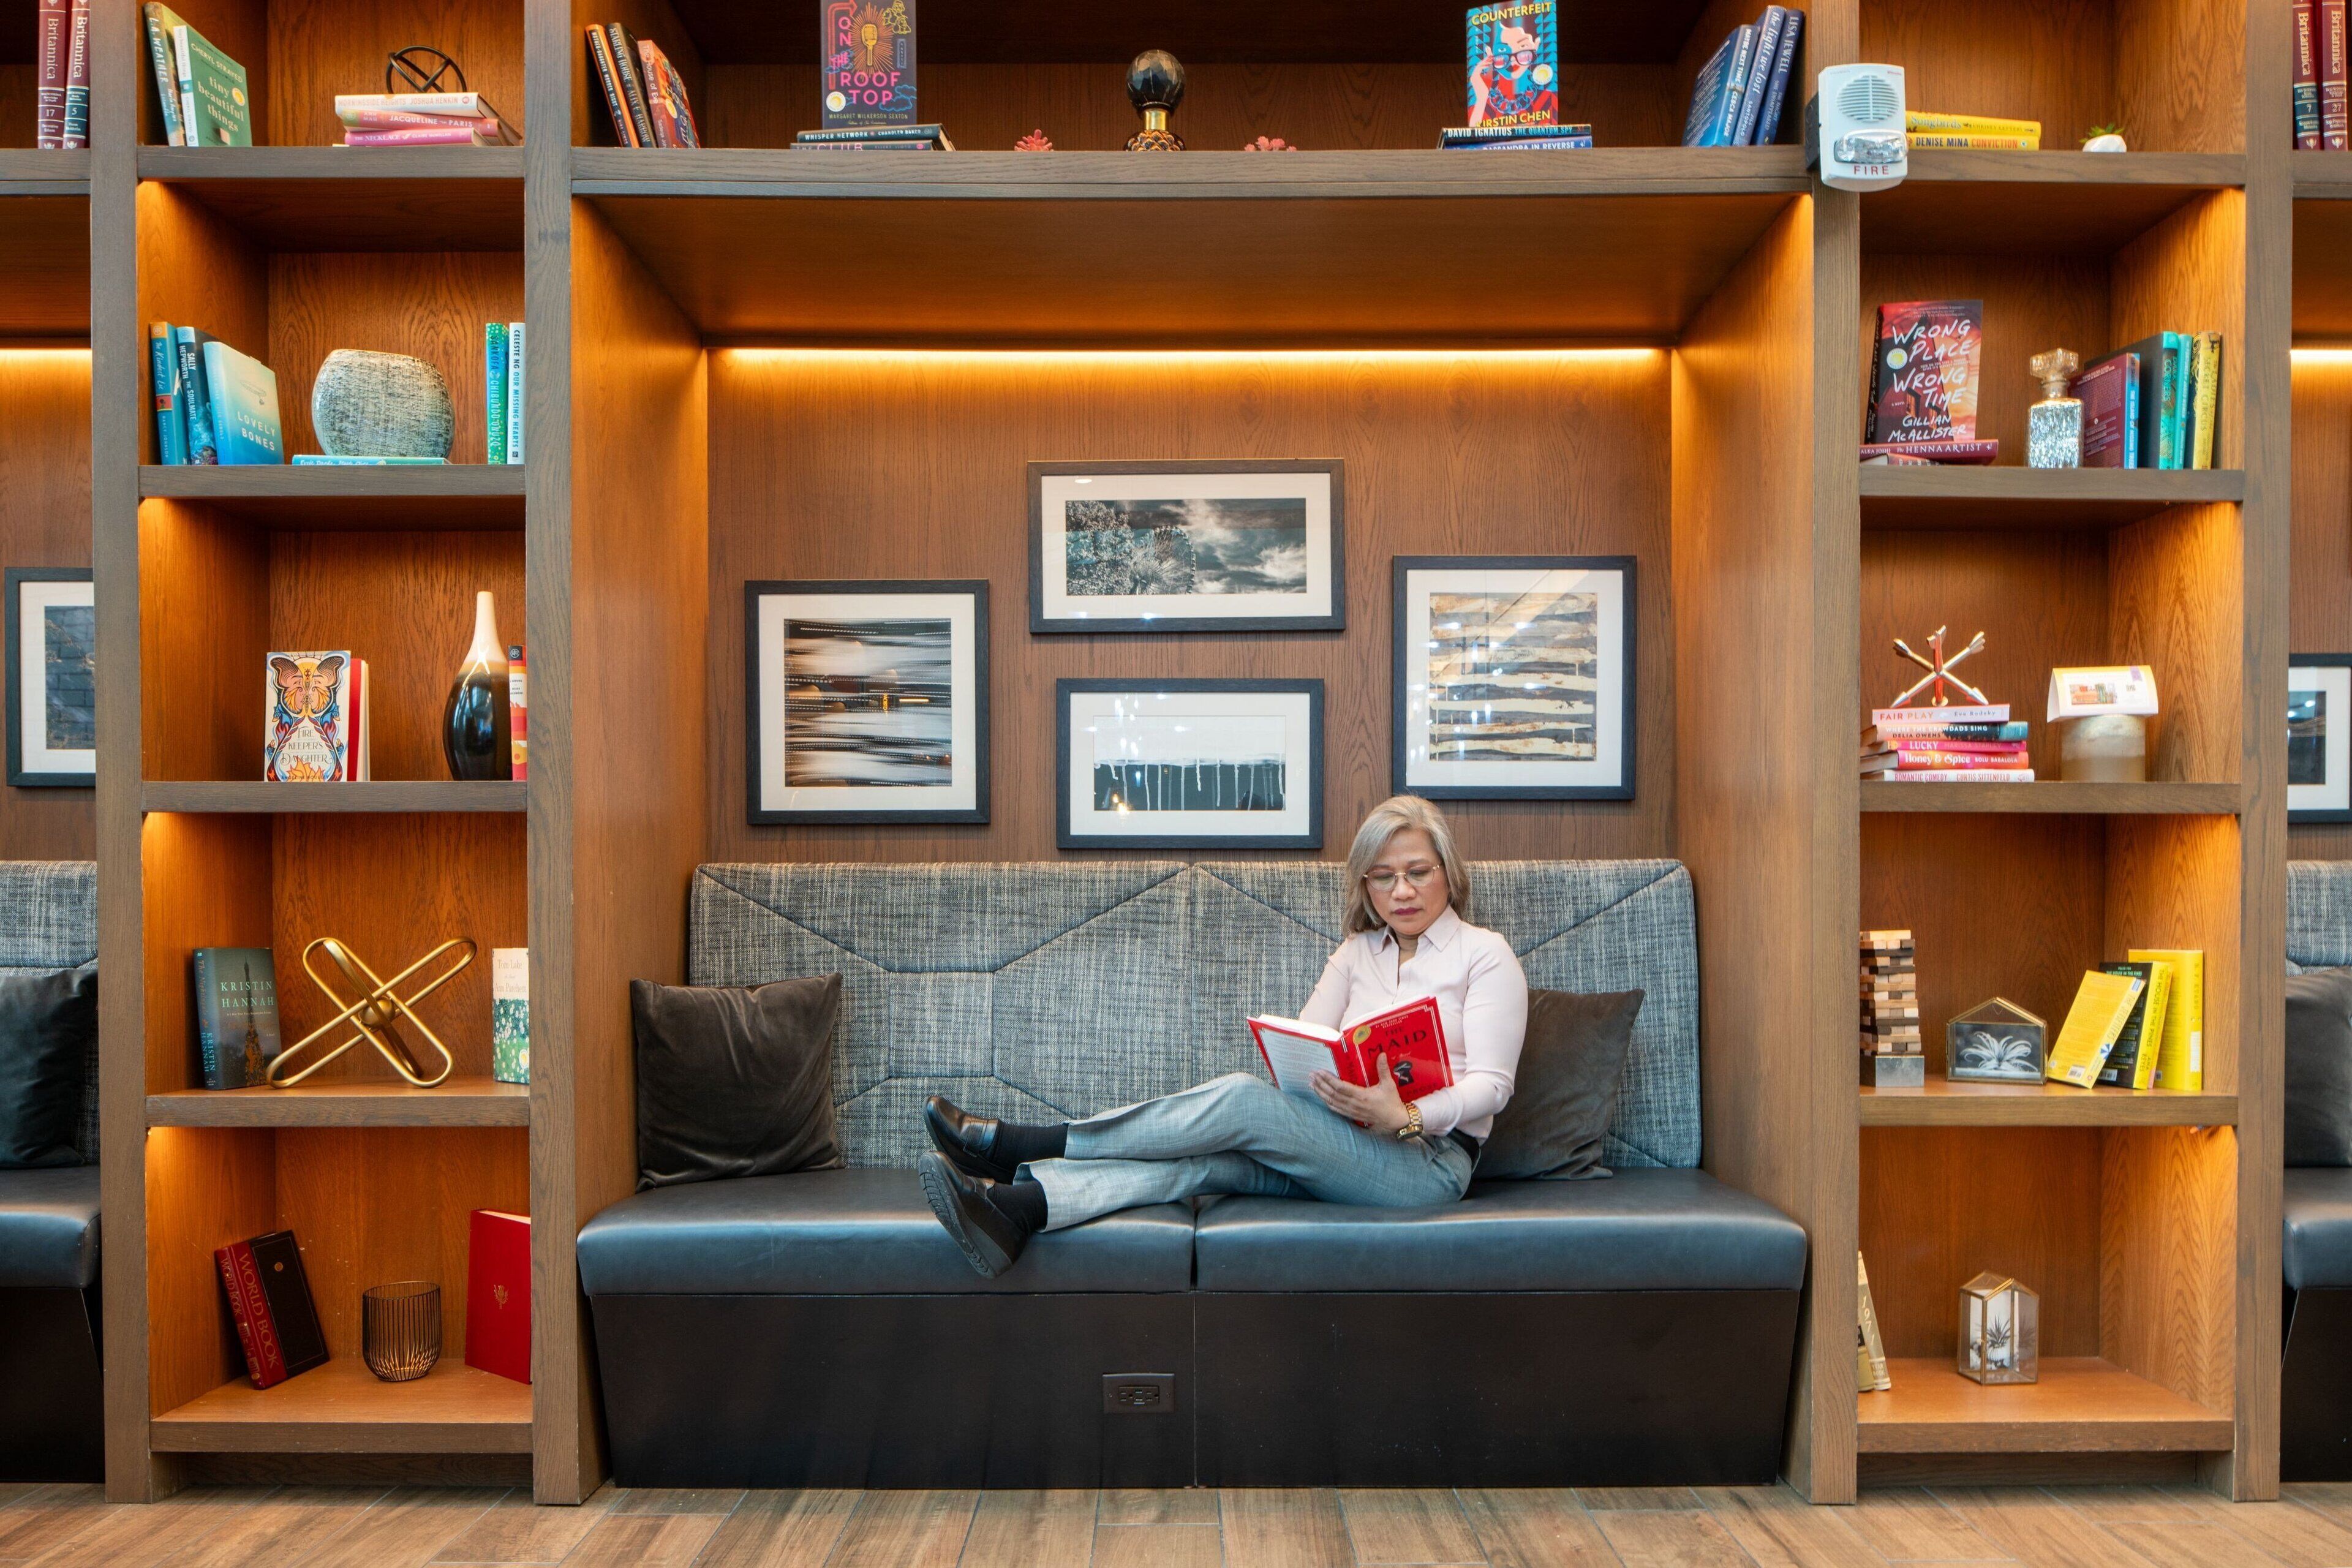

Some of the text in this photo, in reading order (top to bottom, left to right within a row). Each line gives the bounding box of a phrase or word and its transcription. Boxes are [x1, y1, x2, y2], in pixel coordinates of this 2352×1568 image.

[1471, 2, 1553, 26] COUNTERFEIT
[47, 18, 59, 80] Britannica
[73, 17, 88, 78] Britannica
[1752, 12, 1781, 94] the light we lost
[1778, 16, 1799, 74] LISA JEWELL
[2298, 12, 2311, 76] Britannica
[2331, 10, 2342, 75] Britannica
[153, 37, 169, 83] WEATHER
[191, 43, 243, 83] CHERYL STRAYED
[829, 51, 849, 70] THE
[646, 62, 655, 84] House
[840, 71, 901, 88] ROOF
[1724, 29, 1752, 137] MAYBE NEXT TIME CESCA MAJOR
[209, 77, 230, 98] tiny
[609, 28, 651, 143] STARLING HOUSE ALIX HARROW
[848, 89, 893, 105] TOP
[198, 81, 244, 122] beautiful
[410, 97, 434, 105] JOSHUA
[435, 96, 458, 105] HENKIN
[2306, 104, 2312, 113] 7
[2332, 103, 2342, 113] 27
[208, 104, 239, 132] things
[388, 115, 438, 125] JACQUELINE
[1475, 110, 1551, 127] KIRSTIN CHEN
[1741, 100, 1753, 137] SANTOPOLO
[1911, 115, 1961, 129] Songbirds
[1447, 128, 1471, 138] DAVID
[1475, 127, 1512, 137] IGNATIUS
[1916, 137, 2018, 149] DENISE MINA CONVICTION
[1542, 141, 1575, 149] REVERSE
[1854, 165, 1890, 176] FIRE
[1892, 318, 1970, 345] WRONG
[179, 345, 189, 379] HEPWORTH
[187, 352, 196, 371] SALLY
[490, 335, 500, 370] SANKOFA
[1909, 339, 1973, 363] PLACE
[513, 358, 520, 369] NG
[1893, 366, 1966, 393] WRONG
[2163, 359, 2172, 402] CORNERS
[186, 390, 197, 421] SOULMATE
[1923, 386, 1967, 412] TIME
[237, 410, 276, 437] LOVELY
[1902, 413, 1952, 428] GILLIAN
[241, 428, 275, 451] BONES
[1906, 444, 1943, 453] HENNA
[1945, 443, 1982, 453] ARTIST
[298, 726, 314, 738] FIRE
[288, 741, 323, 750] KEEPER'S
[1909, 741, 1939, 750] LUCKY
[1905, 752, 1932, 765] Honey
[1934, 754, 1942, 763] &
[1944, 753, 1971, 766] Spice
[497, 959, 522, 969] Tom Lake
[221, 981, 273, 991] KRISTIN
[495, 982, 527, 993] Ann Patchett
[2153, 982, 2163, 1006] HOUSE
[222, 997, 274, 1008] HANNAH
[1368, 1030, 1426, 1058] MAID
[2146, 1030, 2155, 1048] PINES
[201, 1032, 209, 1072] HANNAH
[206, 1033, 216, 1071] KRISTIN
[221, 1258, 243, 1316] WORLD BOOK
[239, 1253, 279, 1368] WORLD BOOK
